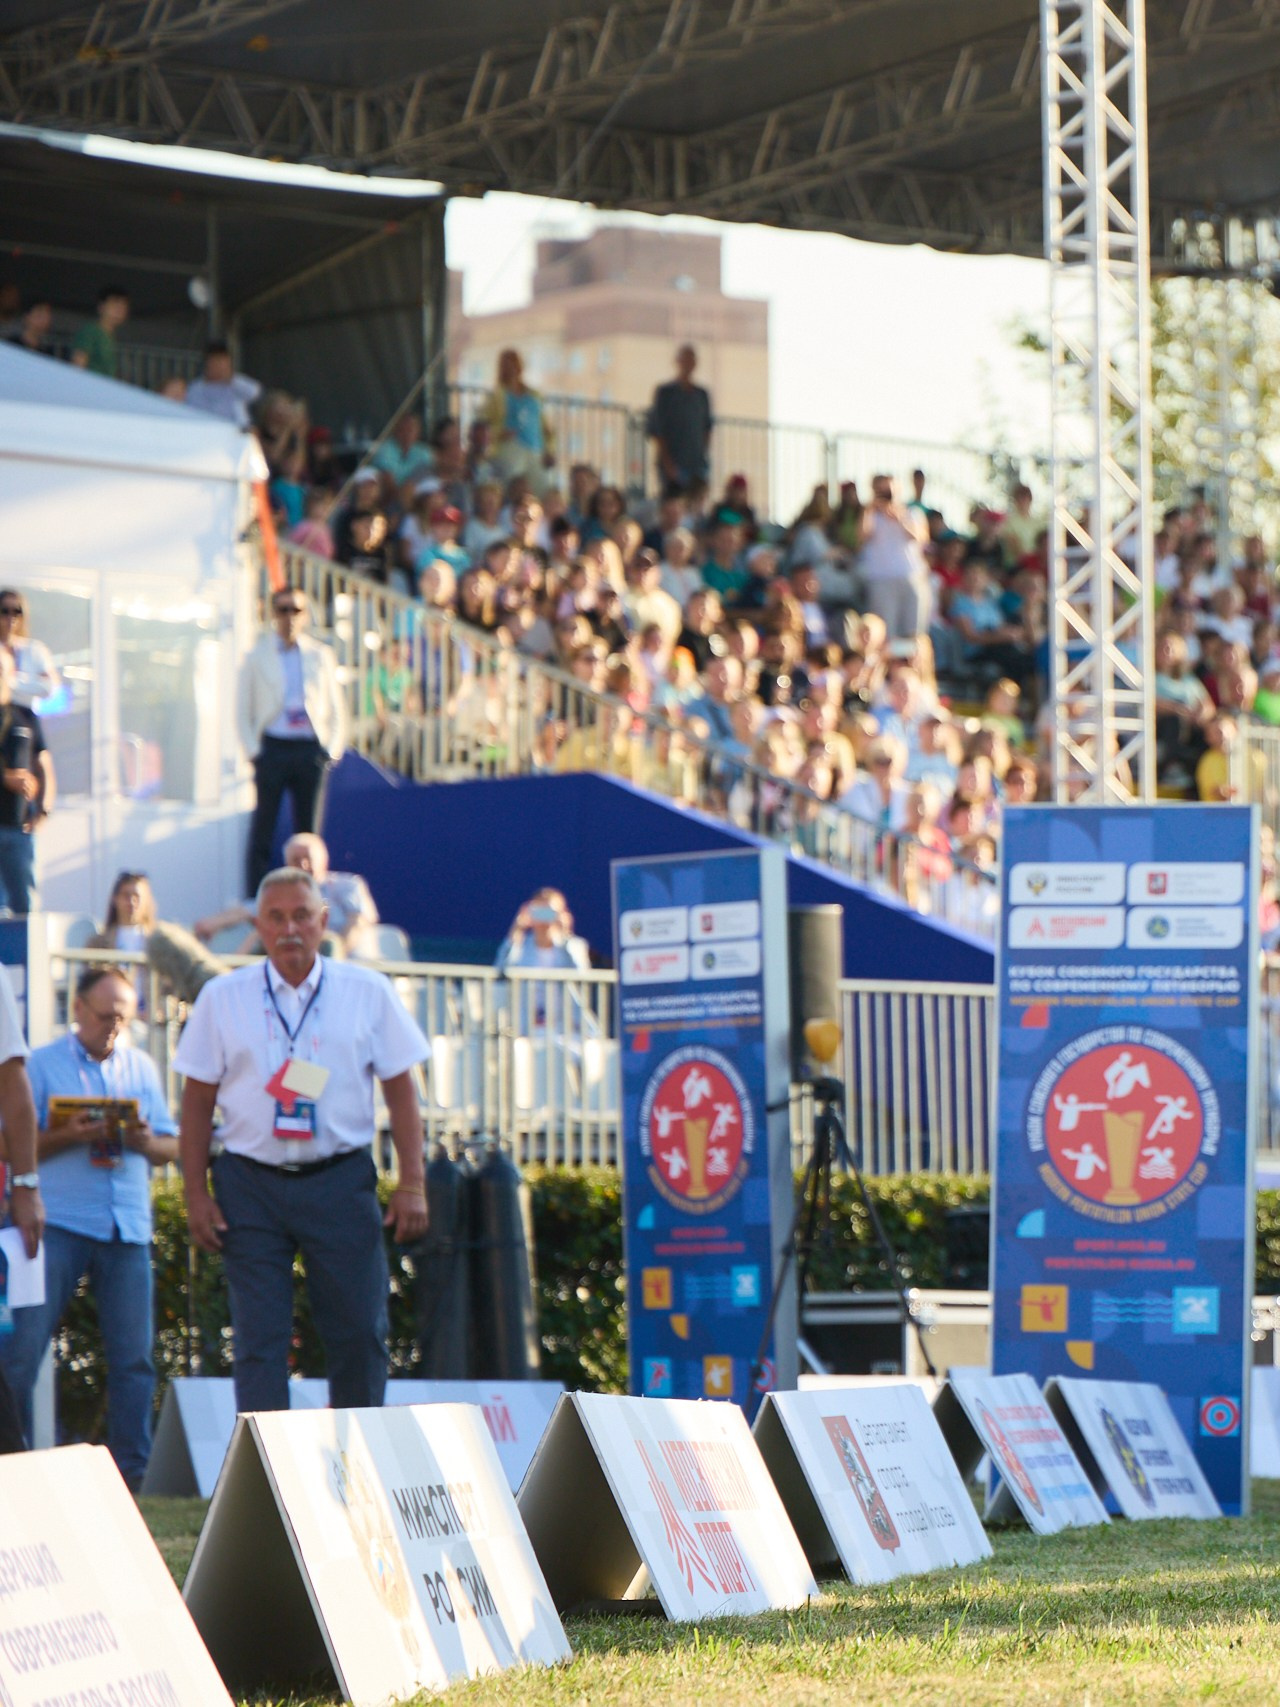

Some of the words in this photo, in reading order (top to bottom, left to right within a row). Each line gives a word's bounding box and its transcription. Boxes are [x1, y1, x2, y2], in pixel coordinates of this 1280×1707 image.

[1009, 979, 1031, 993] ПО
[877, 1466, 910, 1491] спорта
[392, 1481, 486, 1540] МИНСПОРТ
[693, 1521, 756, 1594] СПОРТ
[423, 1565, 499, 1625] РОССИИ
[0, 1610, 118, 1675] СОВРЕМЕННОГО
